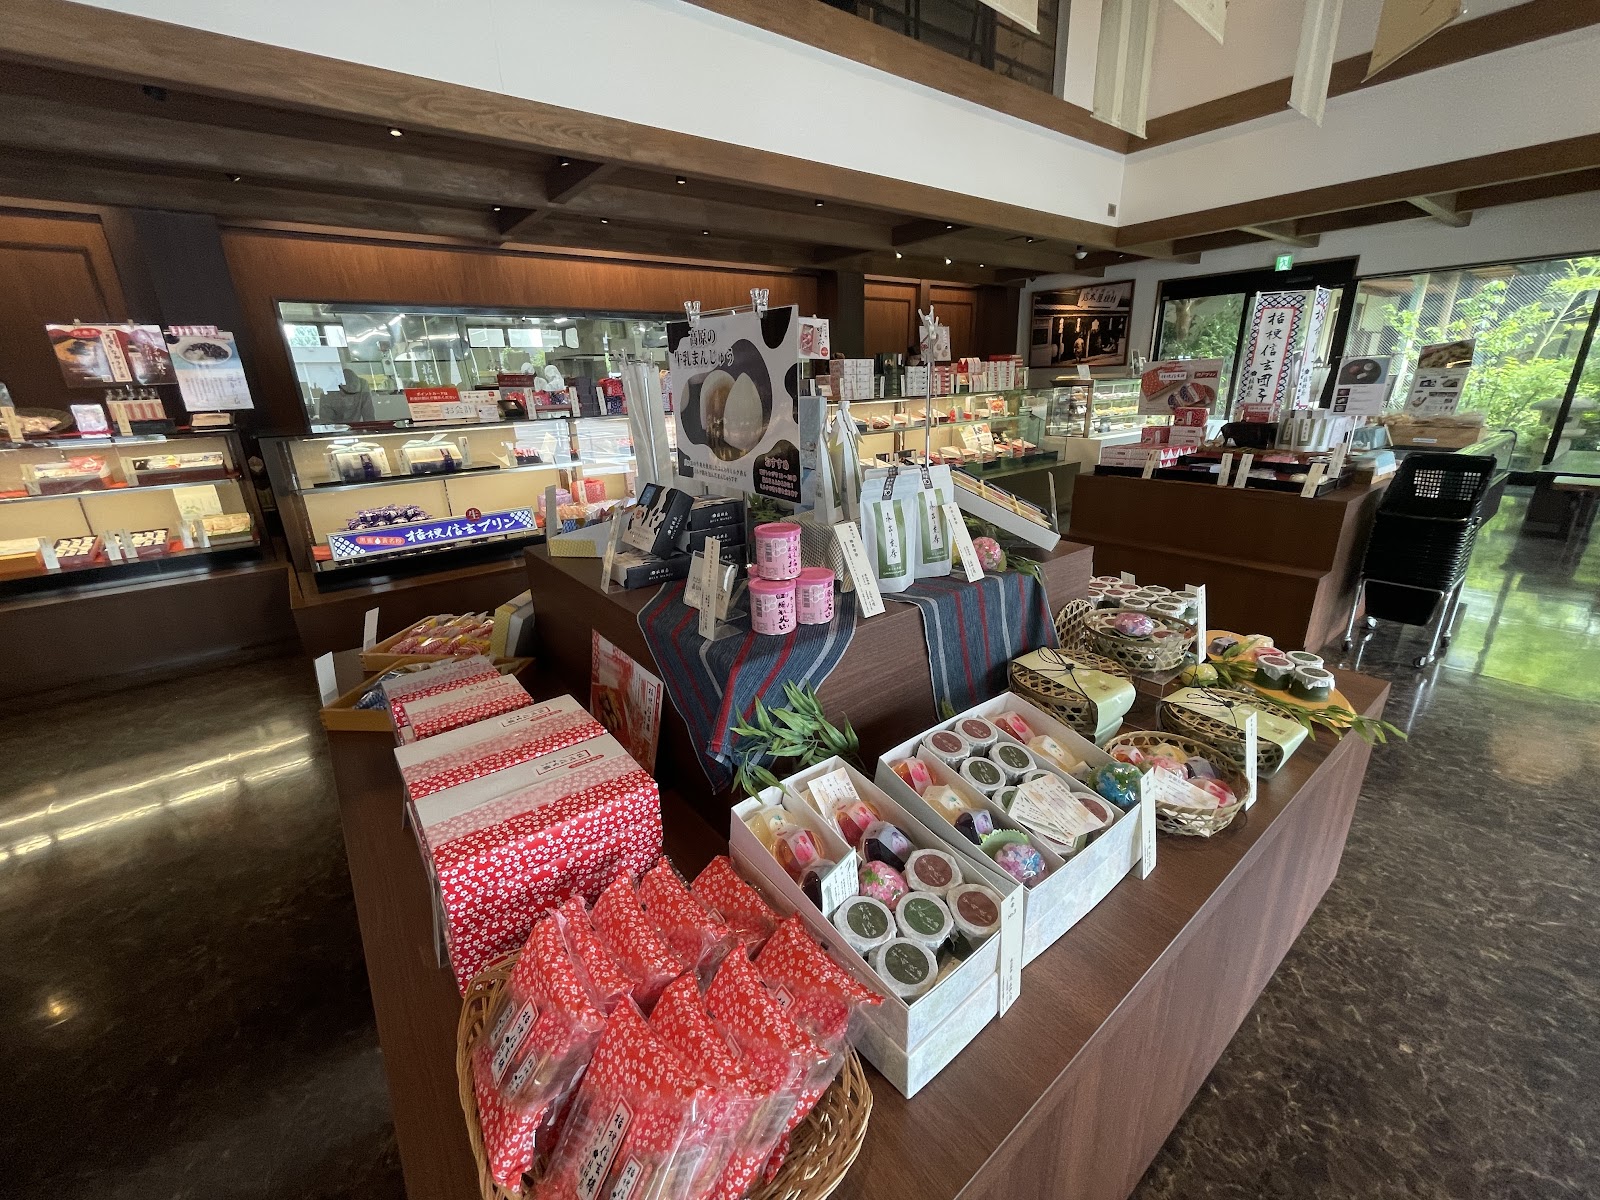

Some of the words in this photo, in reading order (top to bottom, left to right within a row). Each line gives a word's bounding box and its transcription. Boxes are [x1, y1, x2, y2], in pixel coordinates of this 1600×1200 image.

[689, 328, 716, 347] 高原の
[674, 347, 735, 367] 牛乳まんじゅう
[1256, 312, 1286, 403] 桔梗信玄団子
[444, 404, 473, 415] お会計
[764, 456, 790, 471] おすすめ
[468, 509, 479, 521] 生
[405, 517, 516, 543] 桔梗信玄プリン
[586, 1113, 625, 1197] 桔梗信玄棒
